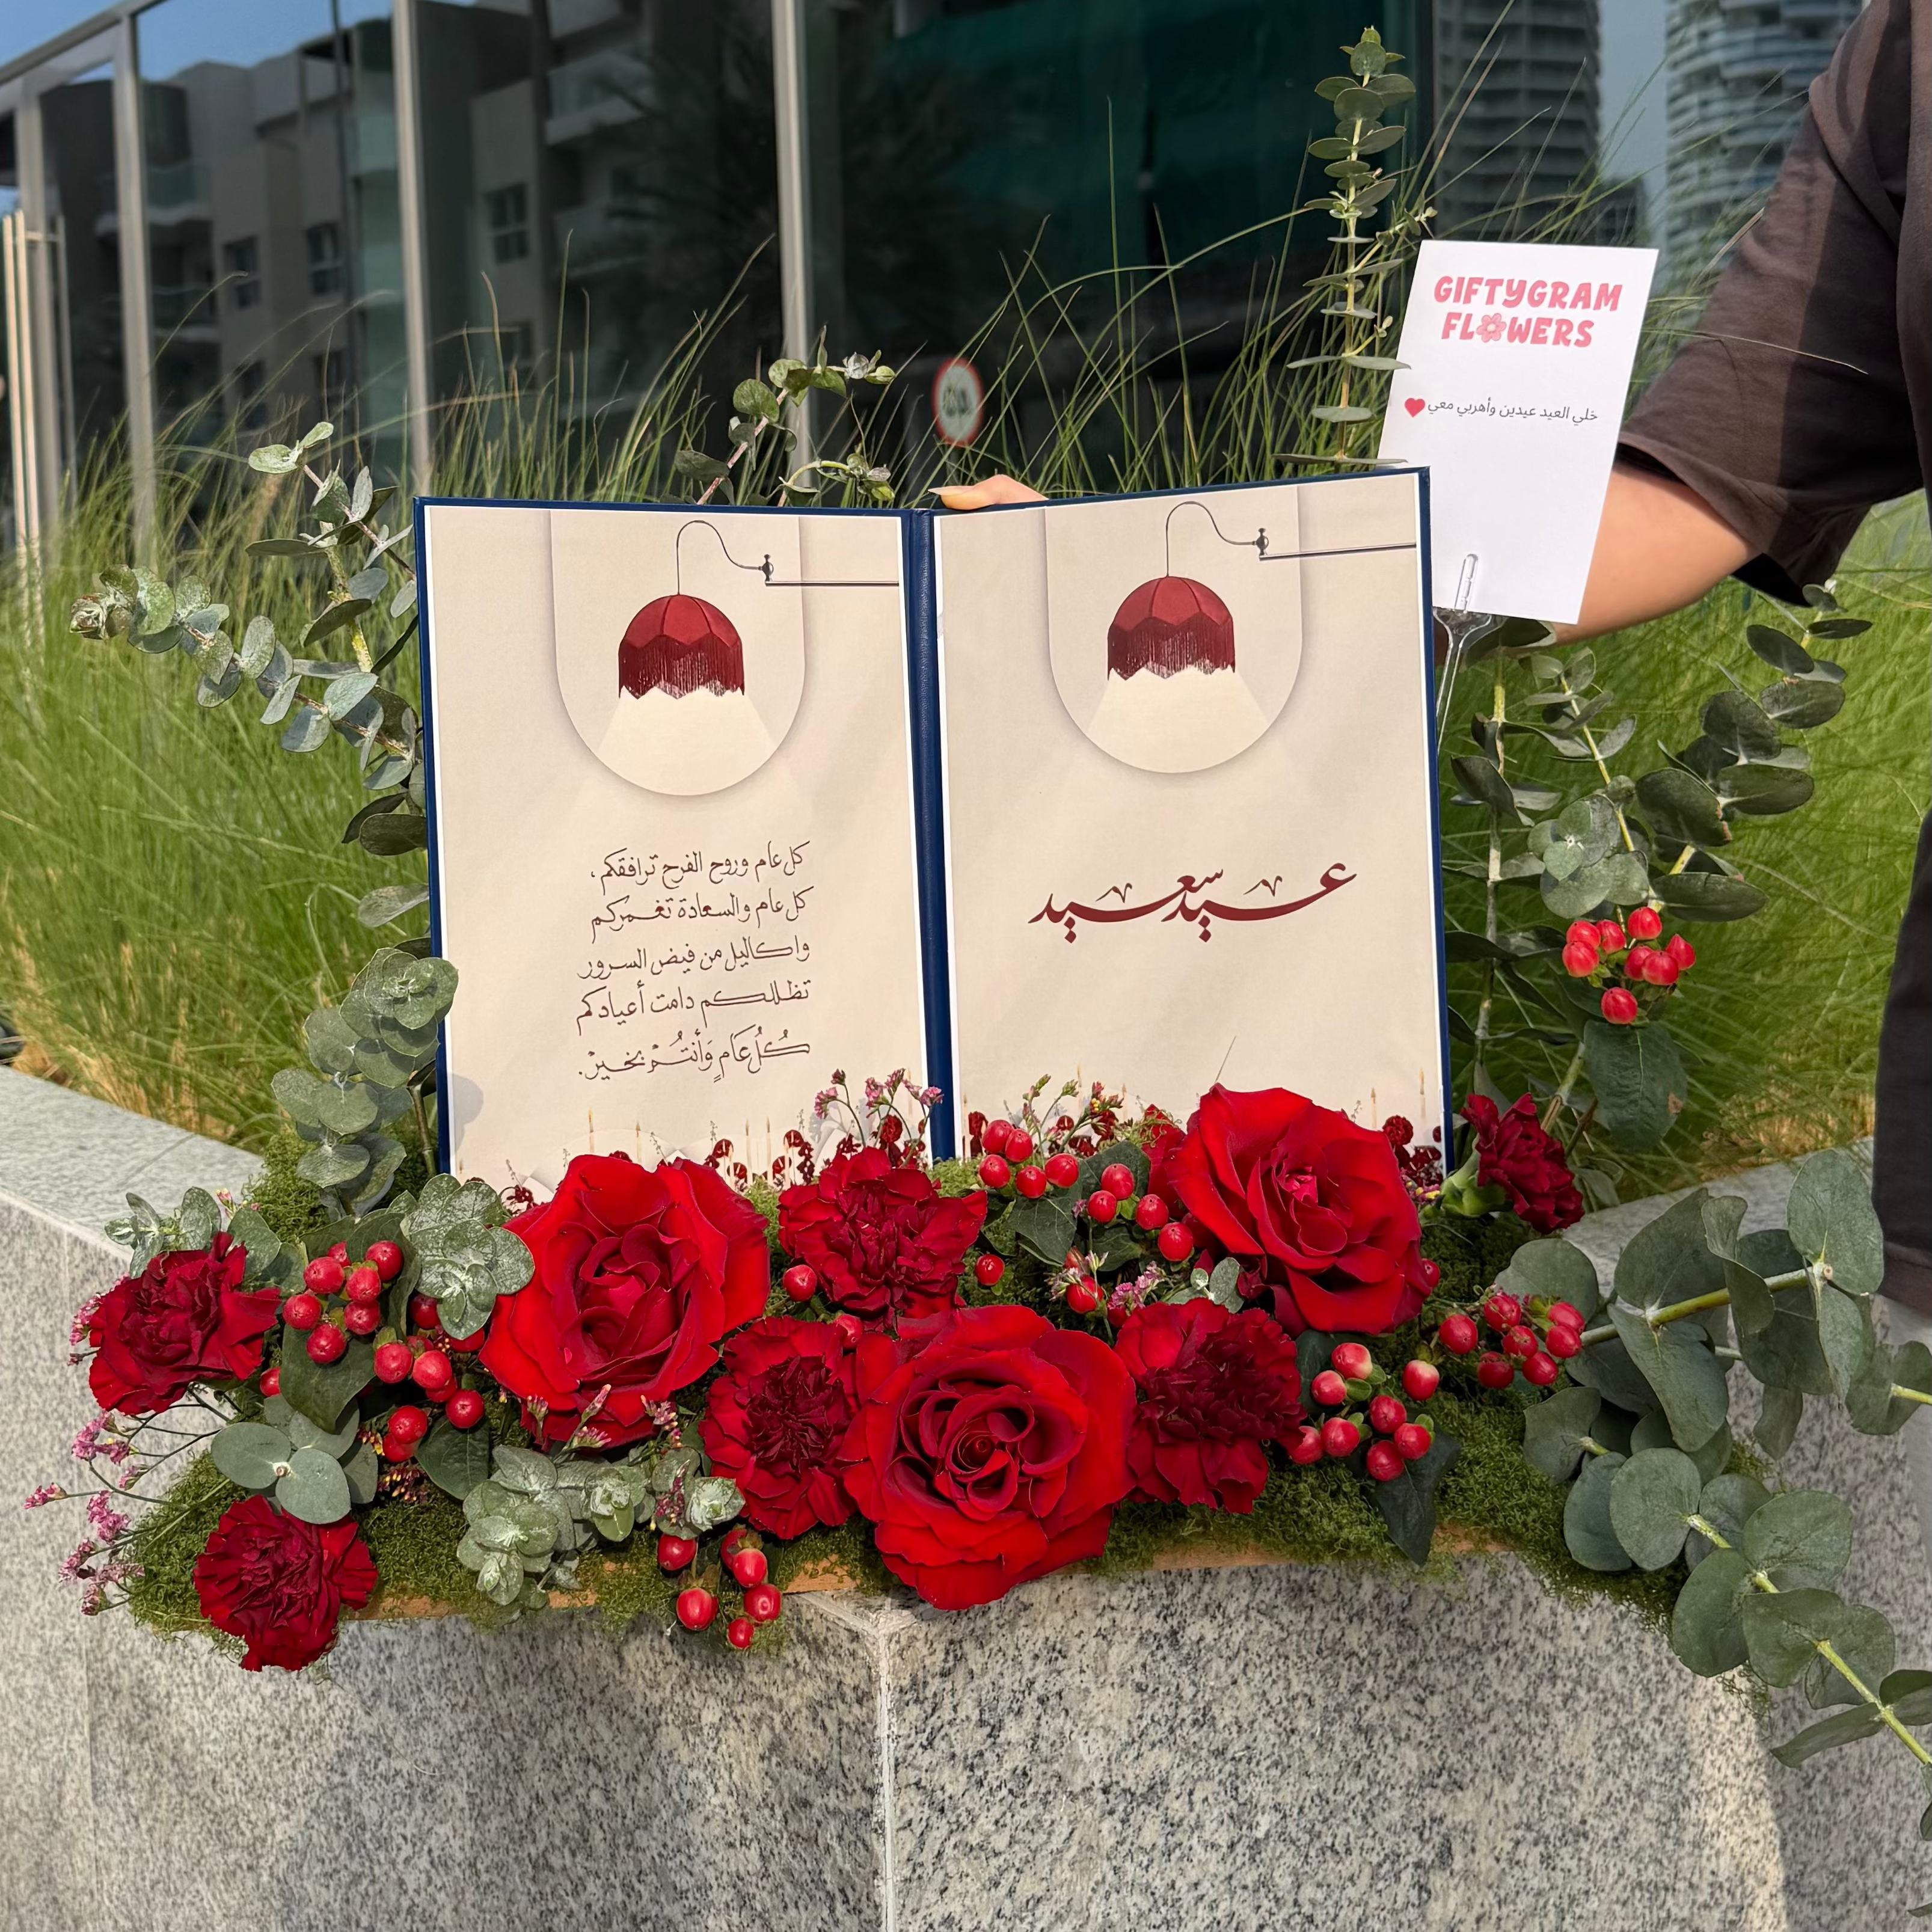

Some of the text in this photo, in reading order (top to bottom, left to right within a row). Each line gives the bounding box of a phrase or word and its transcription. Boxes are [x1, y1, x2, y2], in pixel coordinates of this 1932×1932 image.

[1434, 275, 1623, 311] GIFTYGRAM
[1428, 396, 1598, 426] خلي العيد عيدين وأهربي معي
[661, 851, 703, 890] الفرح
[708, 858, 750, 885] وروح
[755, 840, 782, 883] عام
[783, 840, 811, 877] كل
[678, 892, 751, 923] والسعادة
[755, 887, 784, 929] عام
[785, 885, 814, 922] كل
[1027, 862, 1357, 943] عيد سعيد
[577, 948, 647, 981] السرور
[650, 943, 696, 976] فيض
[699, 949, 722, 971] من
[576, 979, 645, 1037] أعيادكم
[650, 986, 695, 1013] دامت
